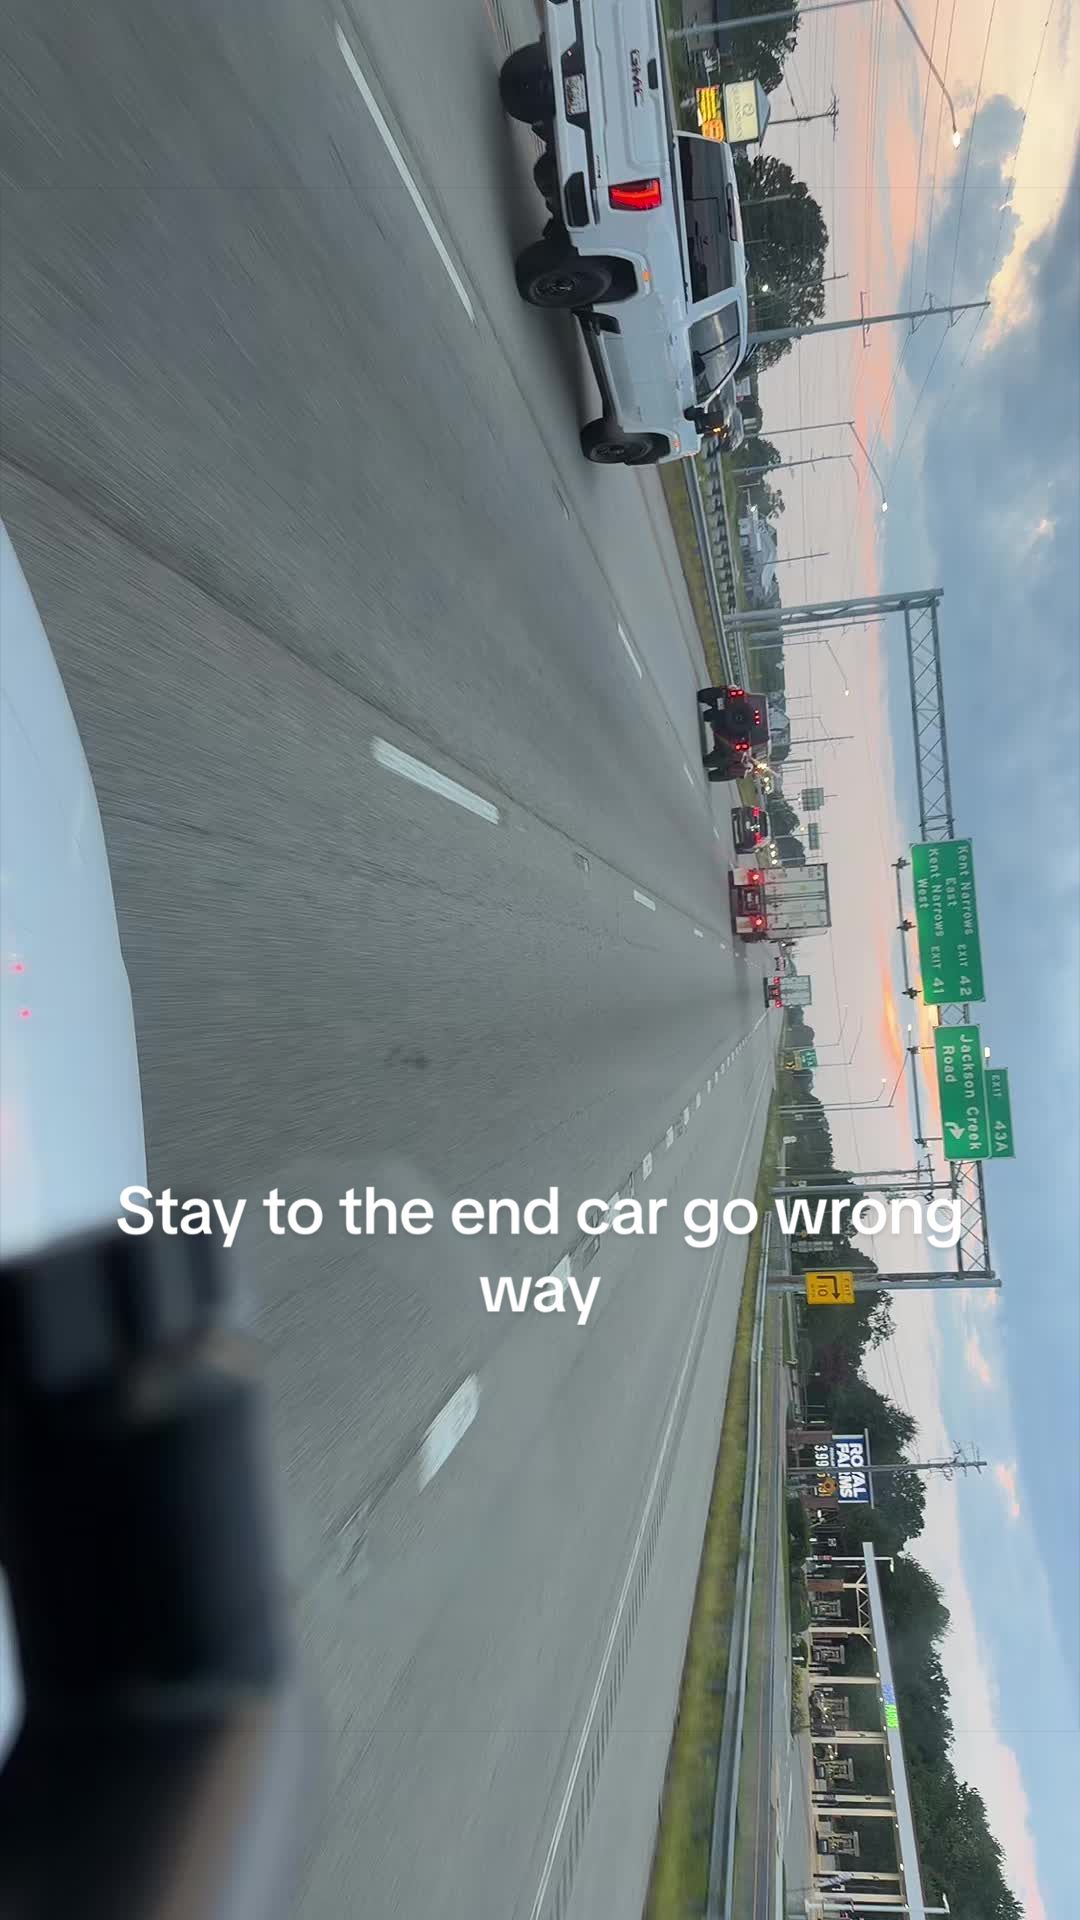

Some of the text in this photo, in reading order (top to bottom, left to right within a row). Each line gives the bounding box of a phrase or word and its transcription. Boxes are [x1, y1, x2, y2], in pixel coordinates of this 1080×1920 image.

[630, 49, 643, 107] GMC
[917, 878, 928, 908] West
[946, 877, 957, 906] East
[928, 849, 944, 993] Kent Narrows EXIT 41
[957, 846, 974, 996] Kent Narrows EXIT 42
[942, 1045, 956, 1082] Road
[960, 1034, 982, 1150] Jackson Creek
[992, 1075, 1008, 1151] EXIT 43A
[818, 1284, 828, 1296] 10
[814, 1445, 829, 1466] 3.99
